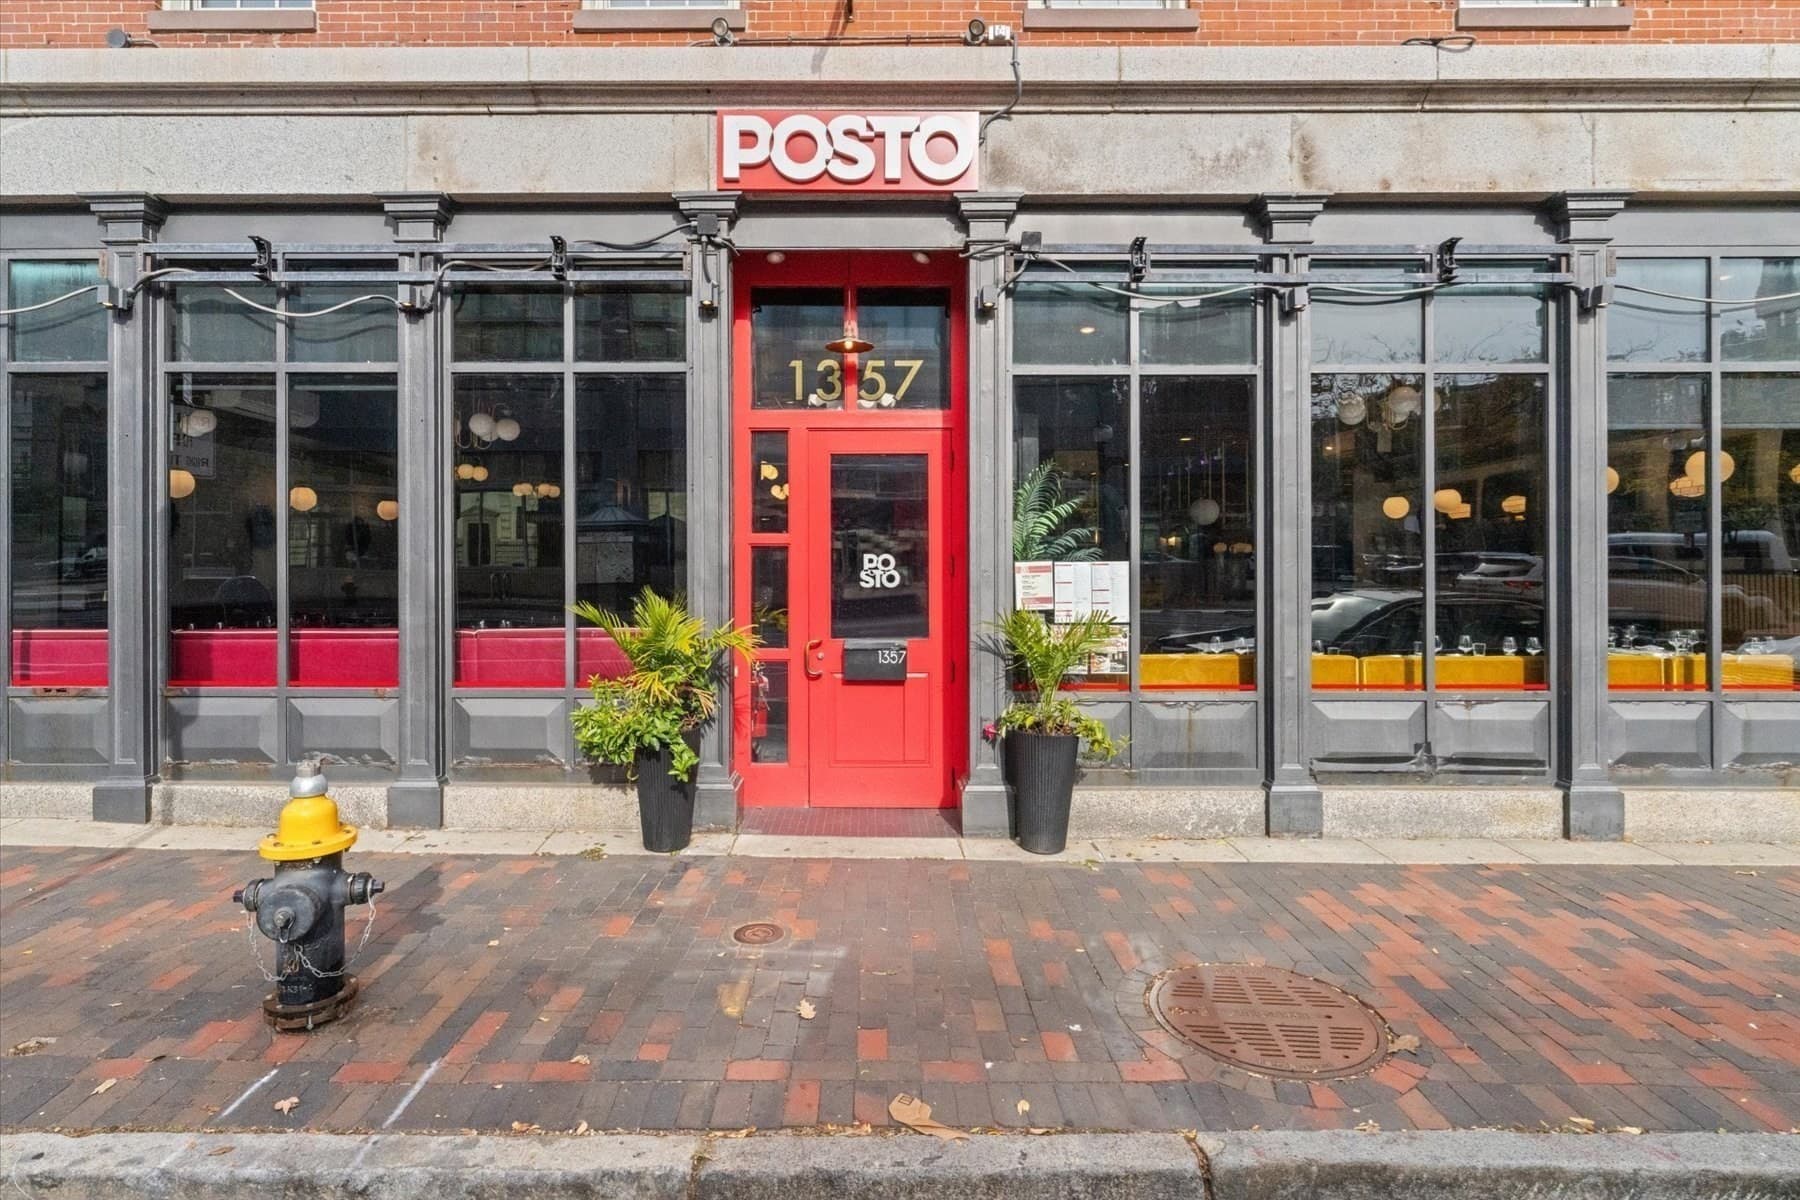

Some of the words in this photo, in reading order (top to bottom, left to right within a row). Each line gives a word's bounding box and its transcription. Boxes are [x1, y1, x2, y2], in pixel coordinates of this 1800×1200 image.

[723, 114, 974, 185] POSTO
[788, 359, 924, 400] 1357
[863, 553, 896, 571] PO
[860, 569, 900, 588] STO
[878, 650, 907, 664] 1357
